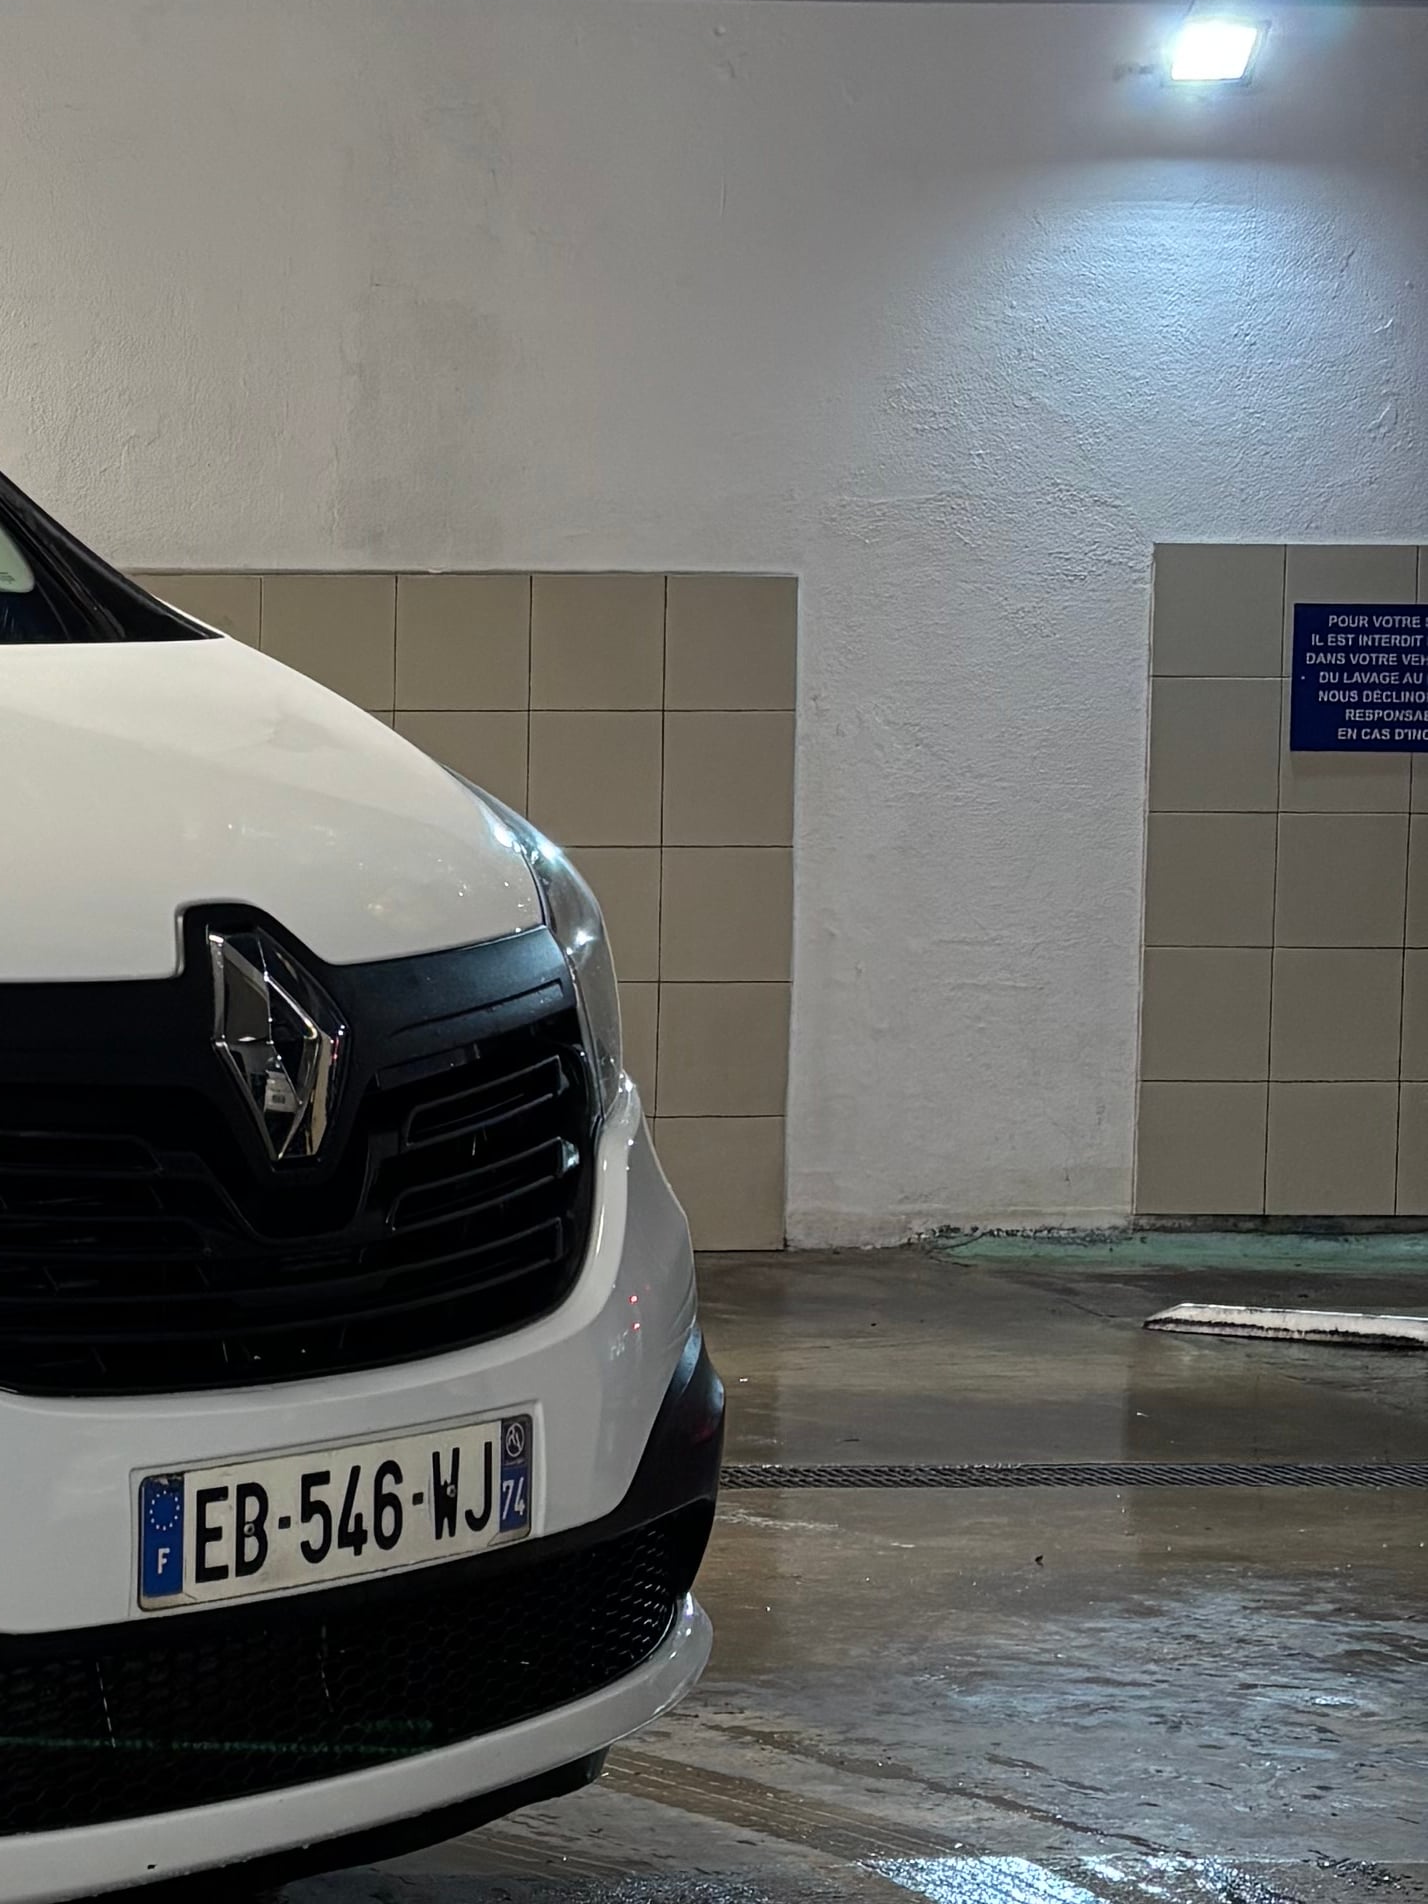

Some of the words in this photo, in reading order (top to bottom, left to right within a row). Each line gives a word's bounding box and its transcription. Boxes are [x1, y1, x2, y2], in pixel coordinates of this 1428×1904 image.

[1328, 615, 1369, 628] POUR
[1372, 615, 1422, 628] VOTRE
[1311, 633, 1324, 646] IL
[1327, 634, 1355, 646] EST
[1358, 634, 1424, 647] INTERDIT
[1305, 652, 1346, 665] DANS
[1350, 653, 1398, 666] VOTRE
[1319, 671, 1339, 684] DU
[1343, 672, 1400, 684] LAVAGE
[1402, 672, 1424, 684] AU
[1318, 690, 1359, 703] NOUS
[1337, 727, 1357, 740] EN
[1361, 728, 1391, 740] CAS
[157, 1547, 171, 1575] F
[194, 1440, 493, 1584] EB-546-WJ
[500, 1476, 527, 1521] 74
